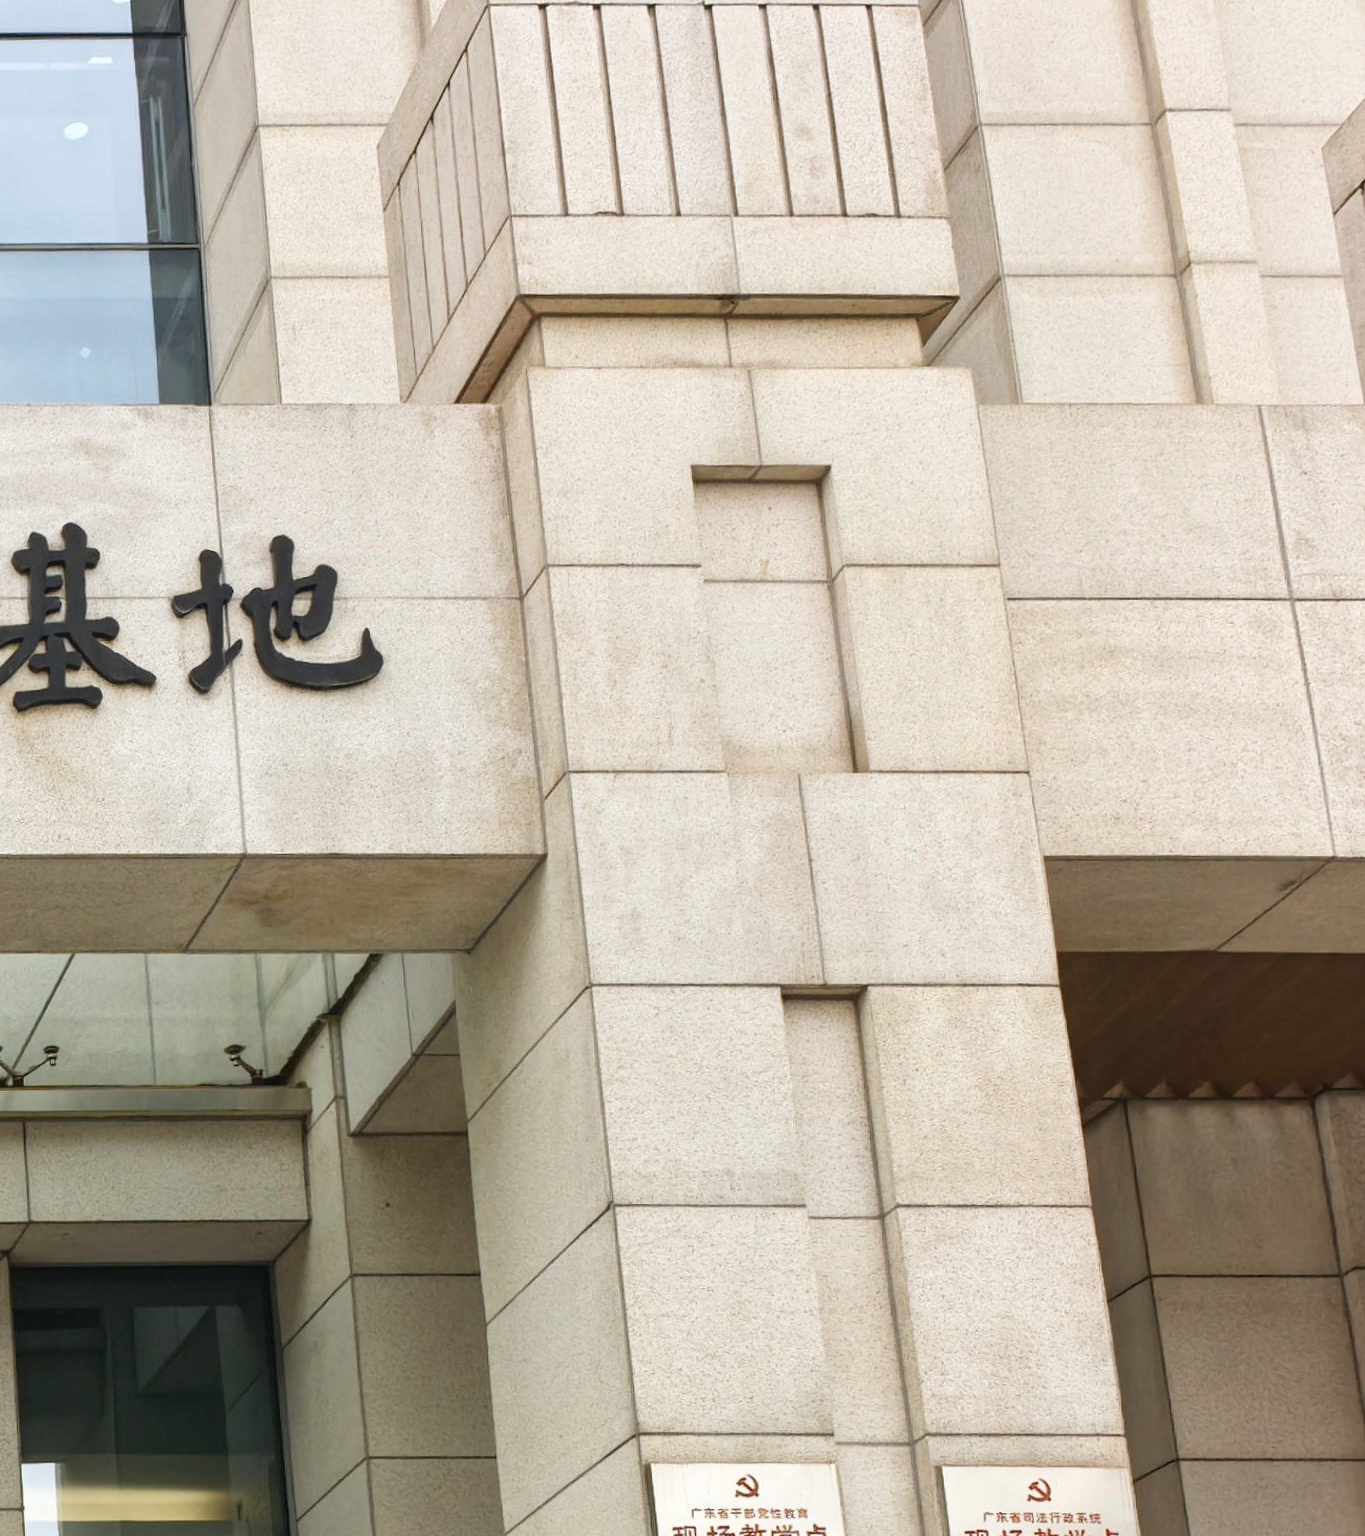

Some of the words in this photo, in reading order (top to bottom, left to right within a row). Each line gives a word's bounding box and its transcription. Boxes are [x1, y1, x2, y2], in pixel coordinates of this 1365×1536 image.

[983, 1512, 1102, 1524] 广东省司法行政系统
